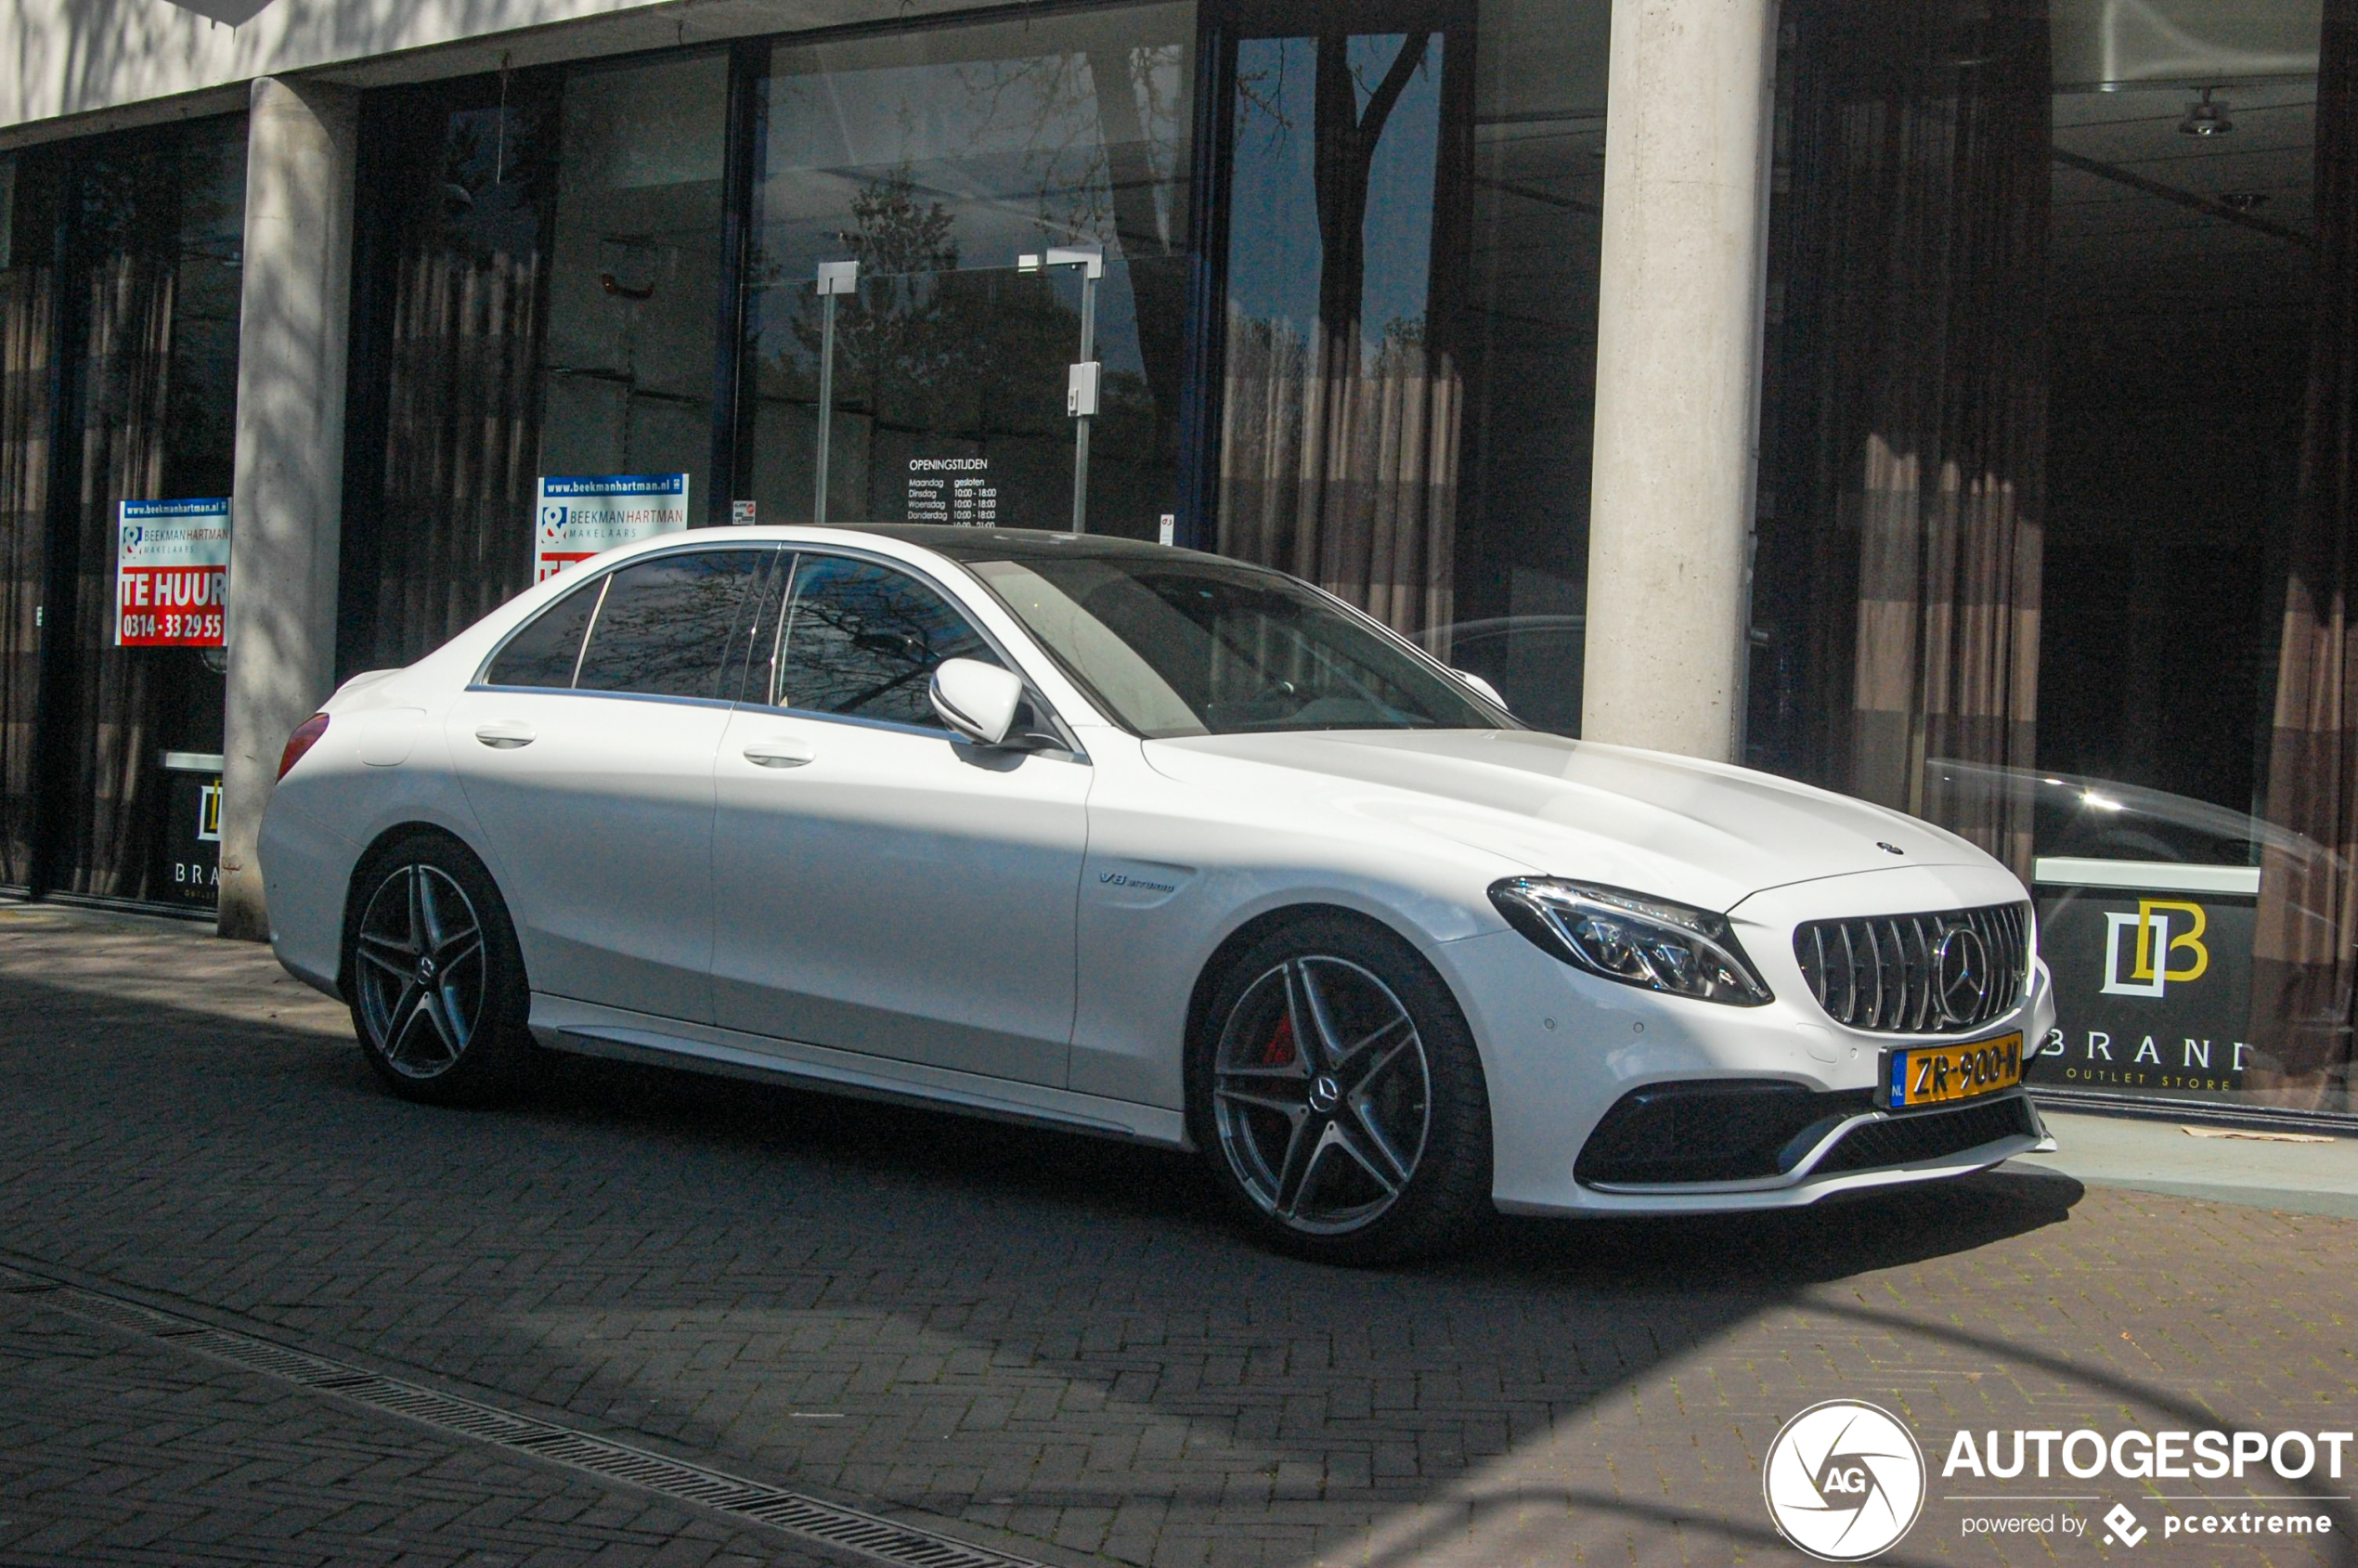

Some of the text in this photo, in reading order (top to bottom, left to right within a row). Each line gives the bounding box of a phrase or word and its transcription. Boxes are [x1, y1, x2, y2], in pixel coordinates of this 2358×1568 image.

[909, 459, 988, 471] OPENINGSTIJDEN
[547, 478, 670, 494] www.beekmanhartman.nl
[909, 478, 985, 488] Maandag gesloten
[908, 489, 937, 499] Dinsdag
[954, 488, 973, 498] 10:00
[978, 488, 997, 498] 18:00
[126, 502, 219, 514] www.beekmanhartman.nl
[907, 500, 946, 510] Woensdag
[953, 499, 972, 509] 10:00
[978, 499, 996, 509] 18:00
[907, 511, 948, 522] Donderdag
[953, 511, 971, 520] 10:00
[978, 511, 996, 520] 18:00
[569, 528, 637, 538] MAKELAARS
[143, 545, 195, 554] MAKELAARS
[121, 572, 227, 606] TE HUUR
[123, 614, 155, 638] 0314
[165, 614, 181, 638] 33
[184, 614, 202, 638] 29
[203, 614, 222, 638] 55
[1099, 871, 1127, 886] V8
[1913, 1040, 2018, 1095] ZR-900-N
[2066, 1068, 2230, 1091] OUTLET STORE
[1891, 1085, 1903, 1096] NL
